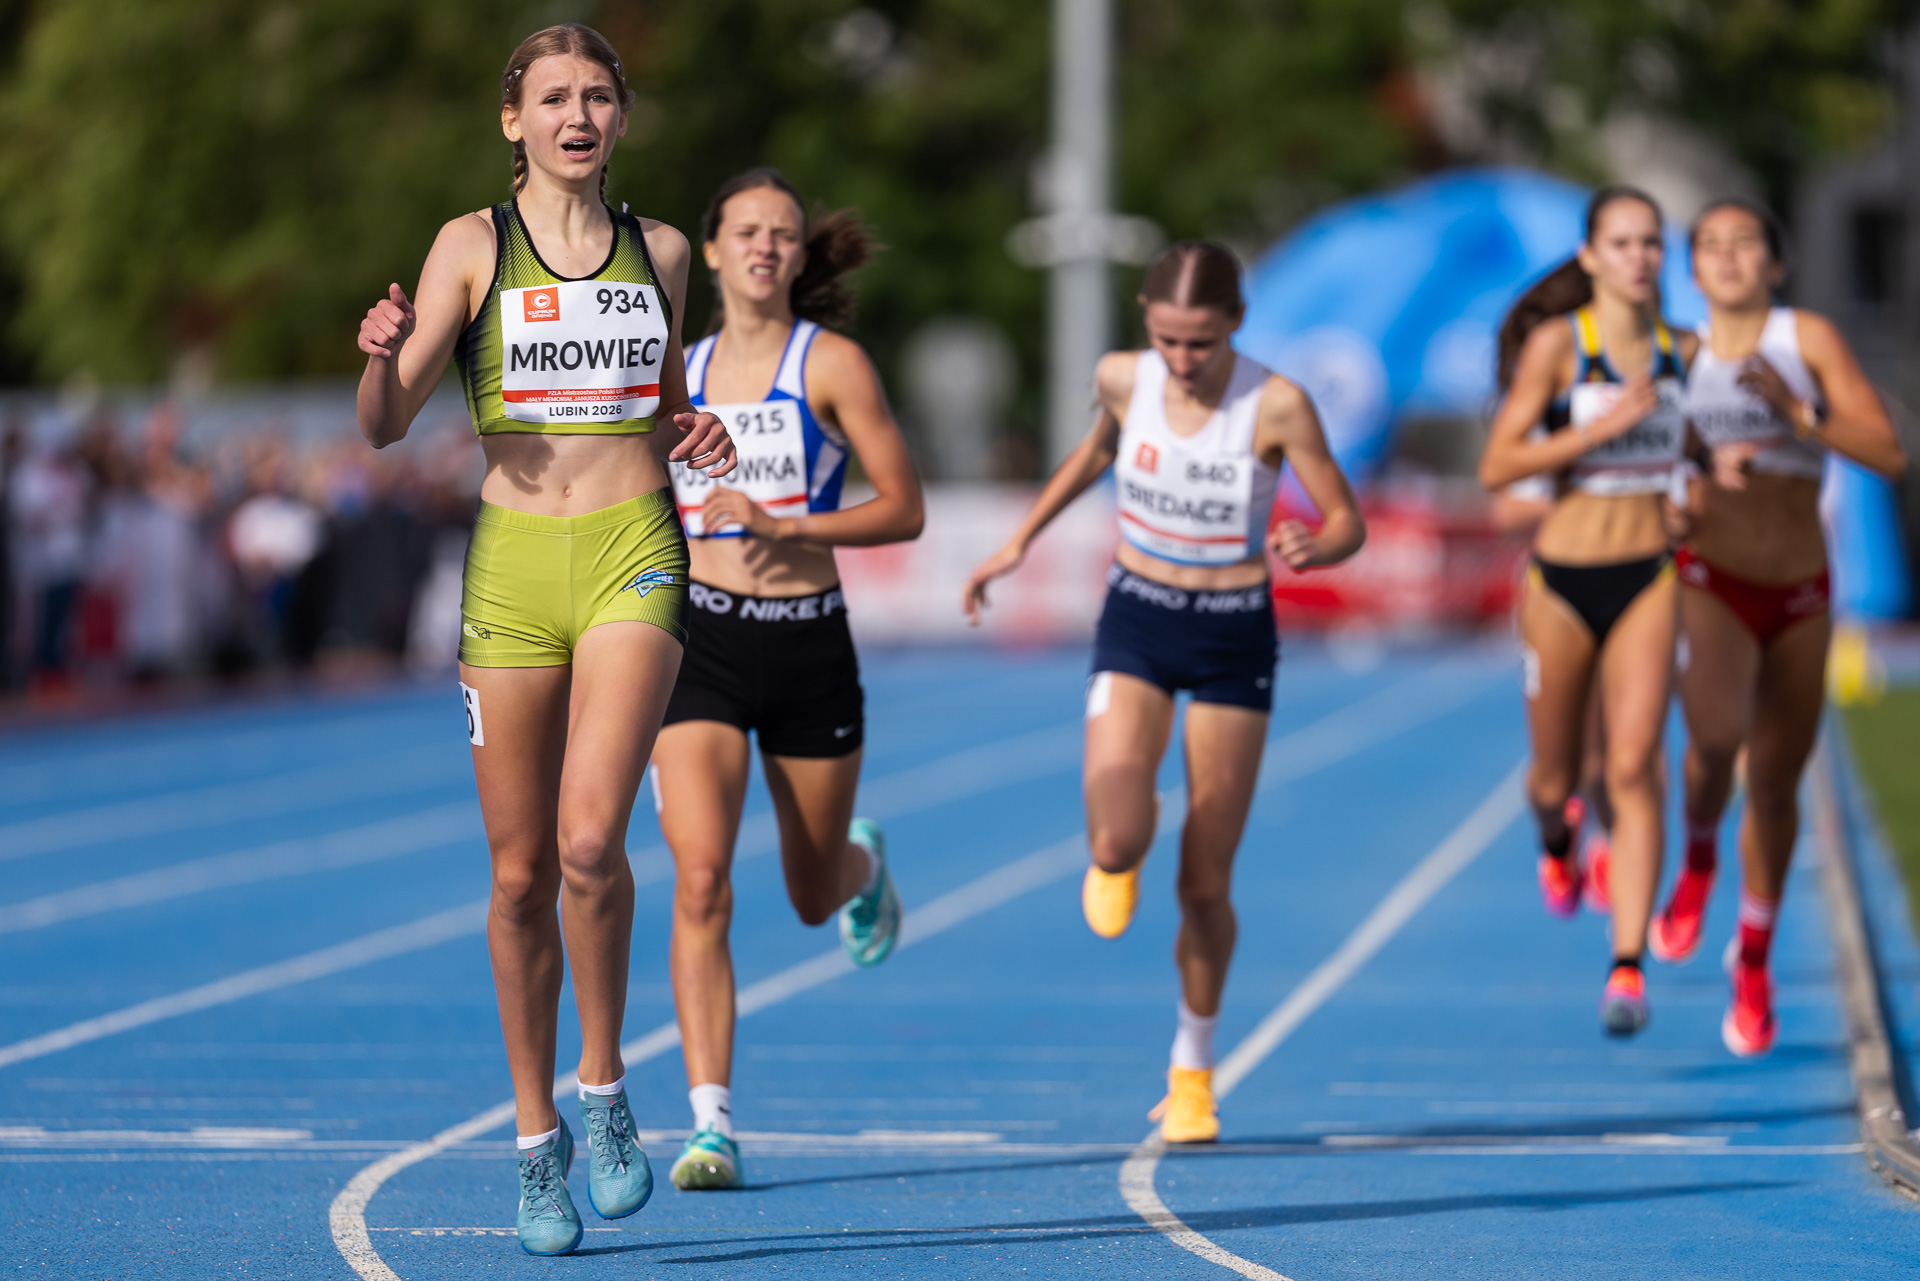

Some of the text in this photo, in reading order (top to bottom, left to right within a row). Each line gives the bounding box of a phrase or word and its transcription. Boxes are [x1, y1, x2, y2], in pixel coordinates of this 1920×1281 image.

[596, 288, 650, 315] 934
[510, 337, 661, 372] MROWIEC
[549, 405, 622, 416] LUBIN 2026
[735, 409, 785, 435] 915
[1186, 462, 1237, 487] 840
[738, 596, 819, 621] NIKE
[1194, 583, 1265, 614] NIKE
